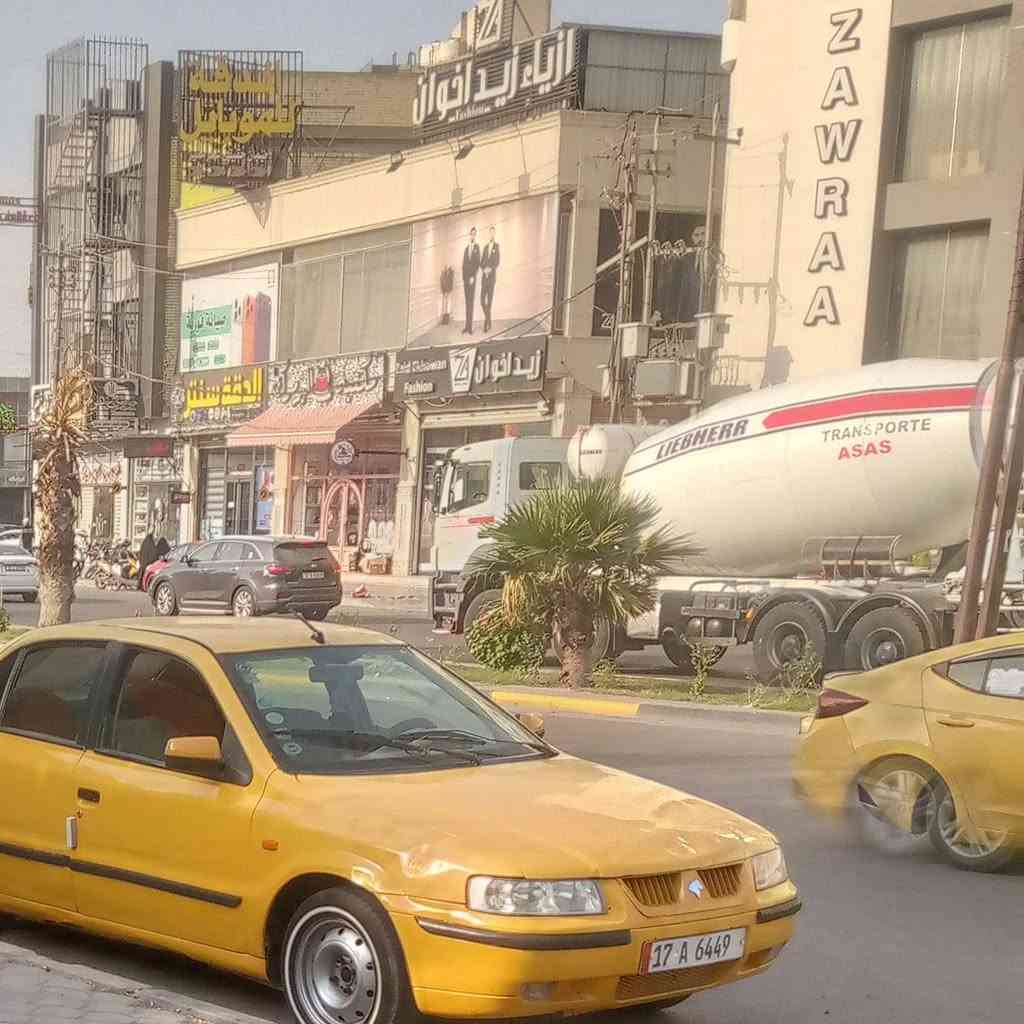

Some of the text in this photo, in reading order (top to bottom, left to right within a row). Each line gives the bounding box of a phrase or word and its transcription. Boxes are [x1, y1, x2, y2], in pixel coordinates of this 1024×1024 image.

[413, 28, 575, 125] ازياء زيد اخوان
[803, 8, 862, 326] ZAWRAA
[475, 349, 541, 383] زيد اخوان
[656, 418, 749, 460] LIEBHERR
[821, 418, 932, 442] TRANSPORTE
[837, 440, 893, 461] ASAS
[652, 943, 673, 967] 17
[678, 941, 688, 964] A
[695, 934, 731, 960] 6449
